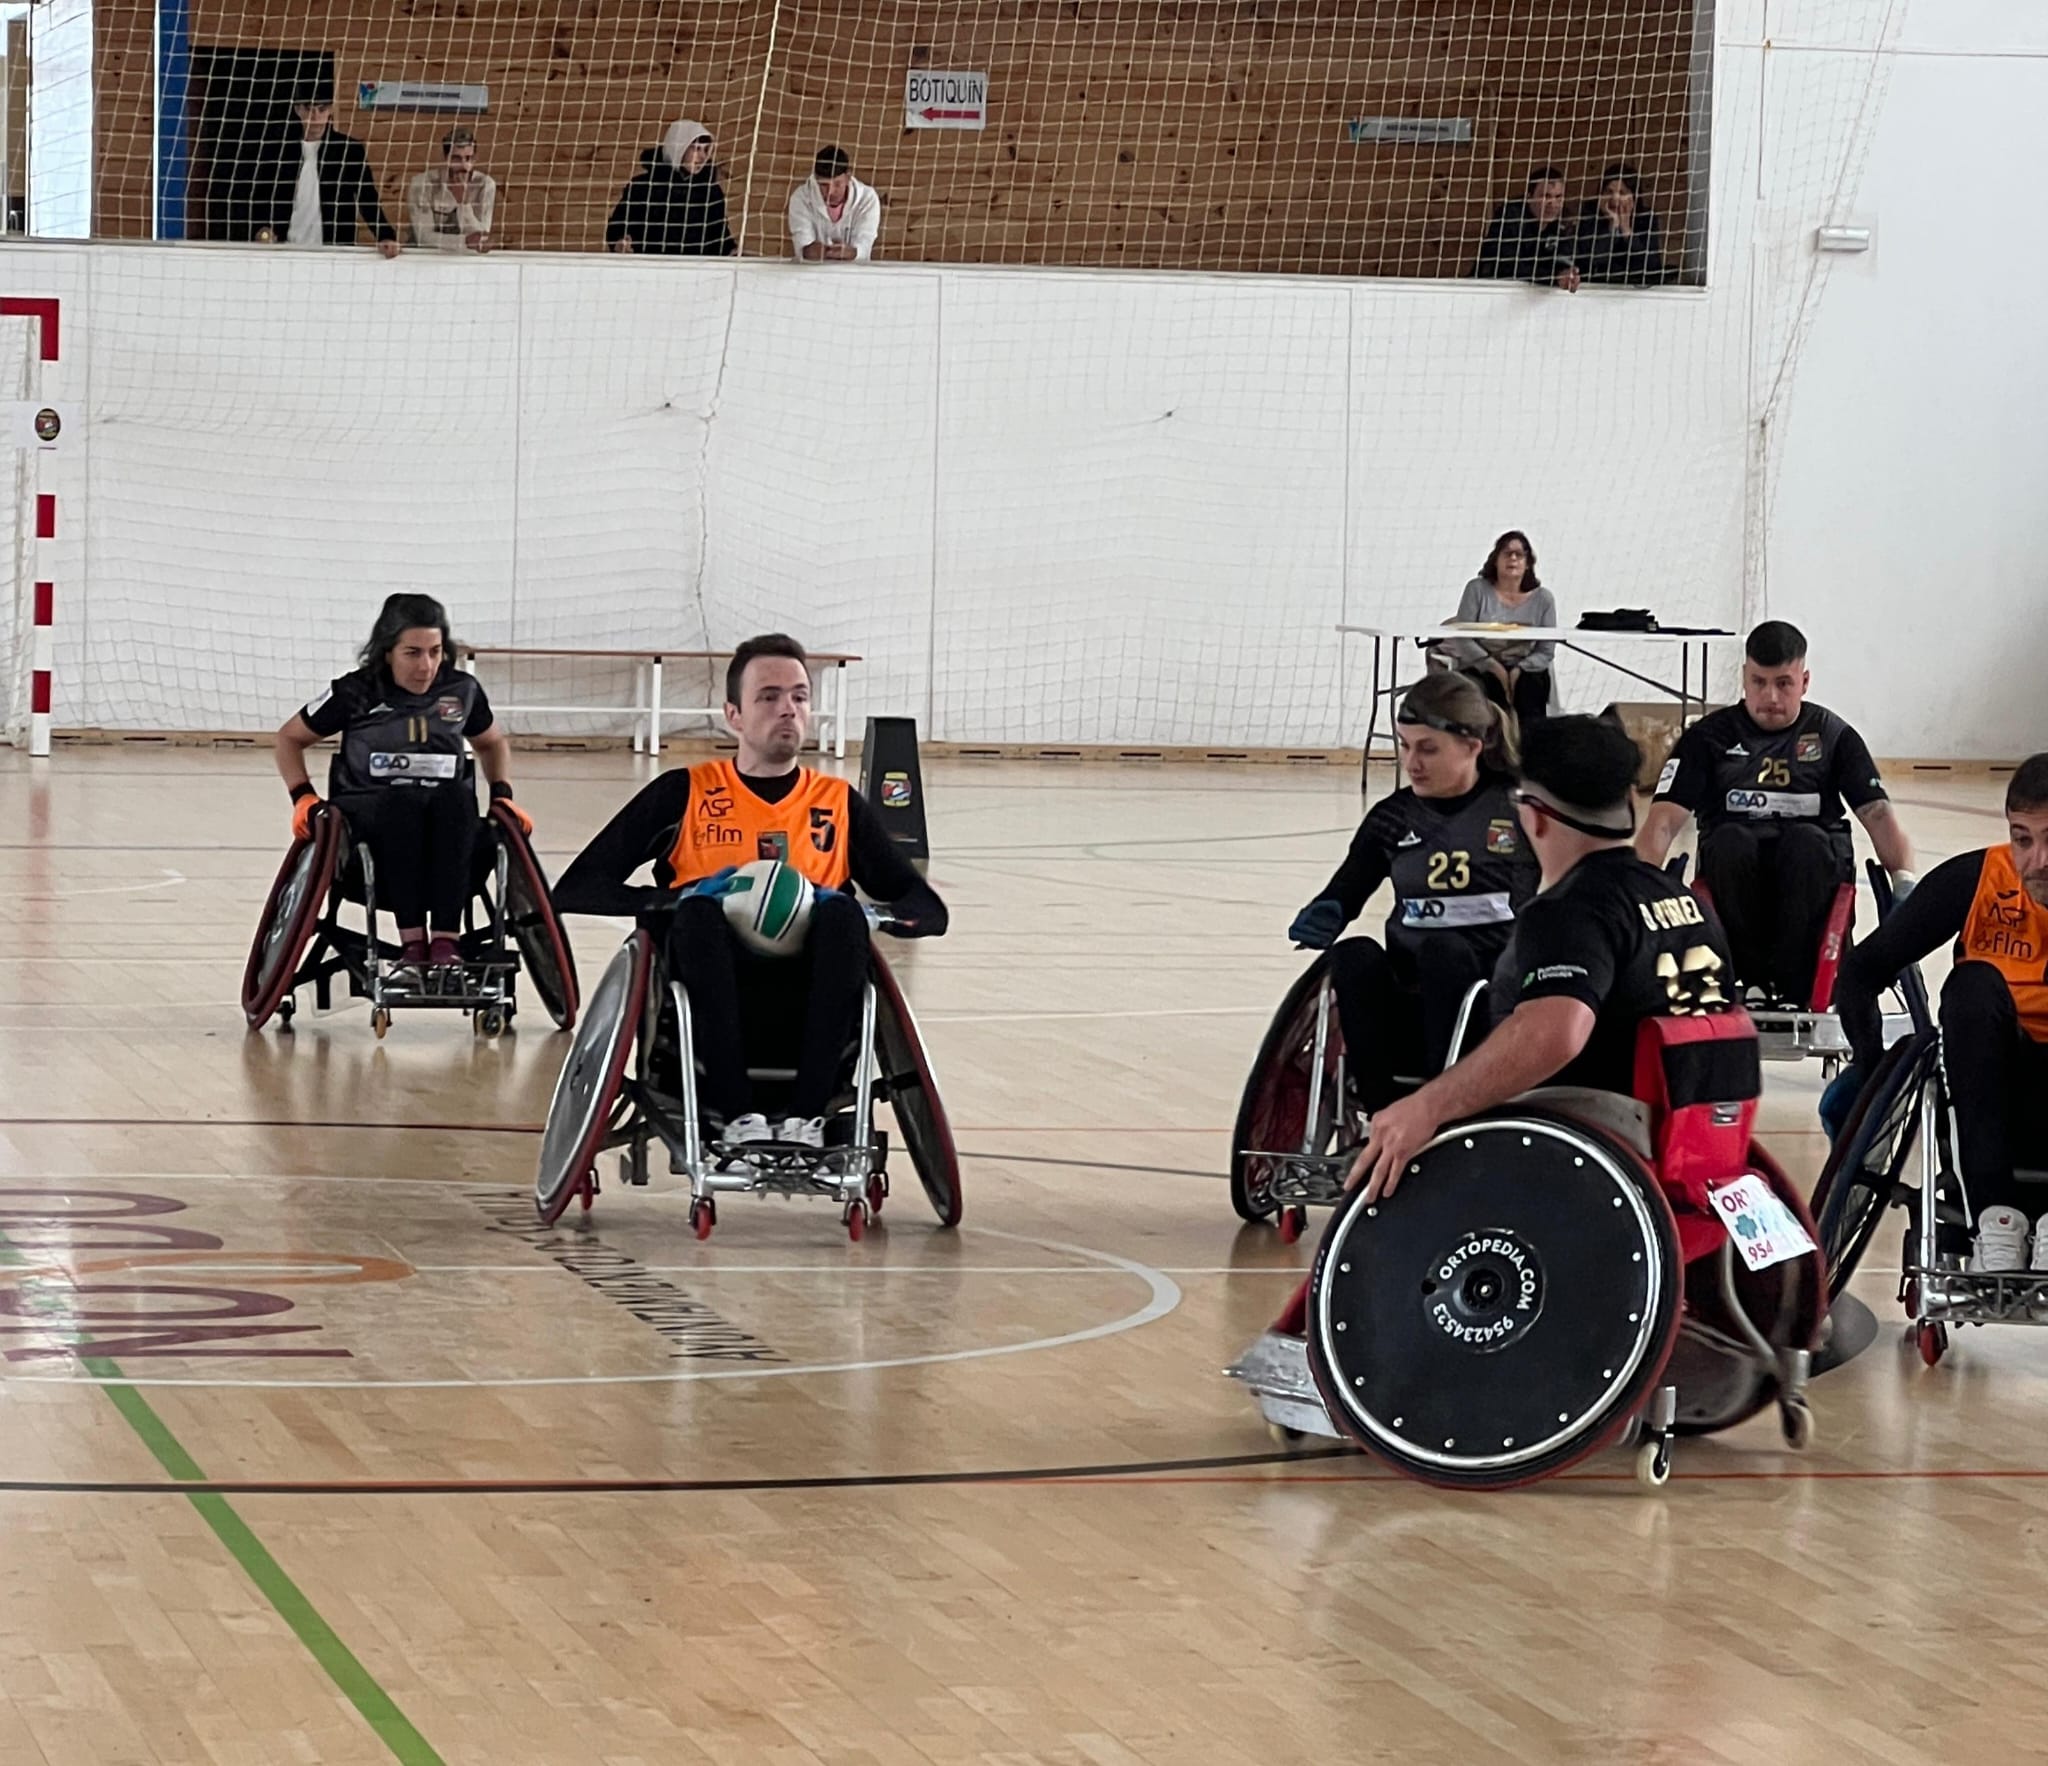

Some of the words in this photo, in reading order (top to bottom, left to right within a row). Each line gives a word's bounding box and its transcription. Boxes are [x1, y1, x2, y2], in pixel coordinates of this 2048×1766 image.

[408, 716, 428, 743] 11
[1757, 757, 1791, 787] 25
[1728, 790, 1768, 808] CAAD
[810, 807, 837, 853] 5
[1427, 851, 1471, 890] 23
[1721, 1188, 1750, 1213] OR
[1439, 1239, 1536, 1311] ORTOPEDIA.COM
